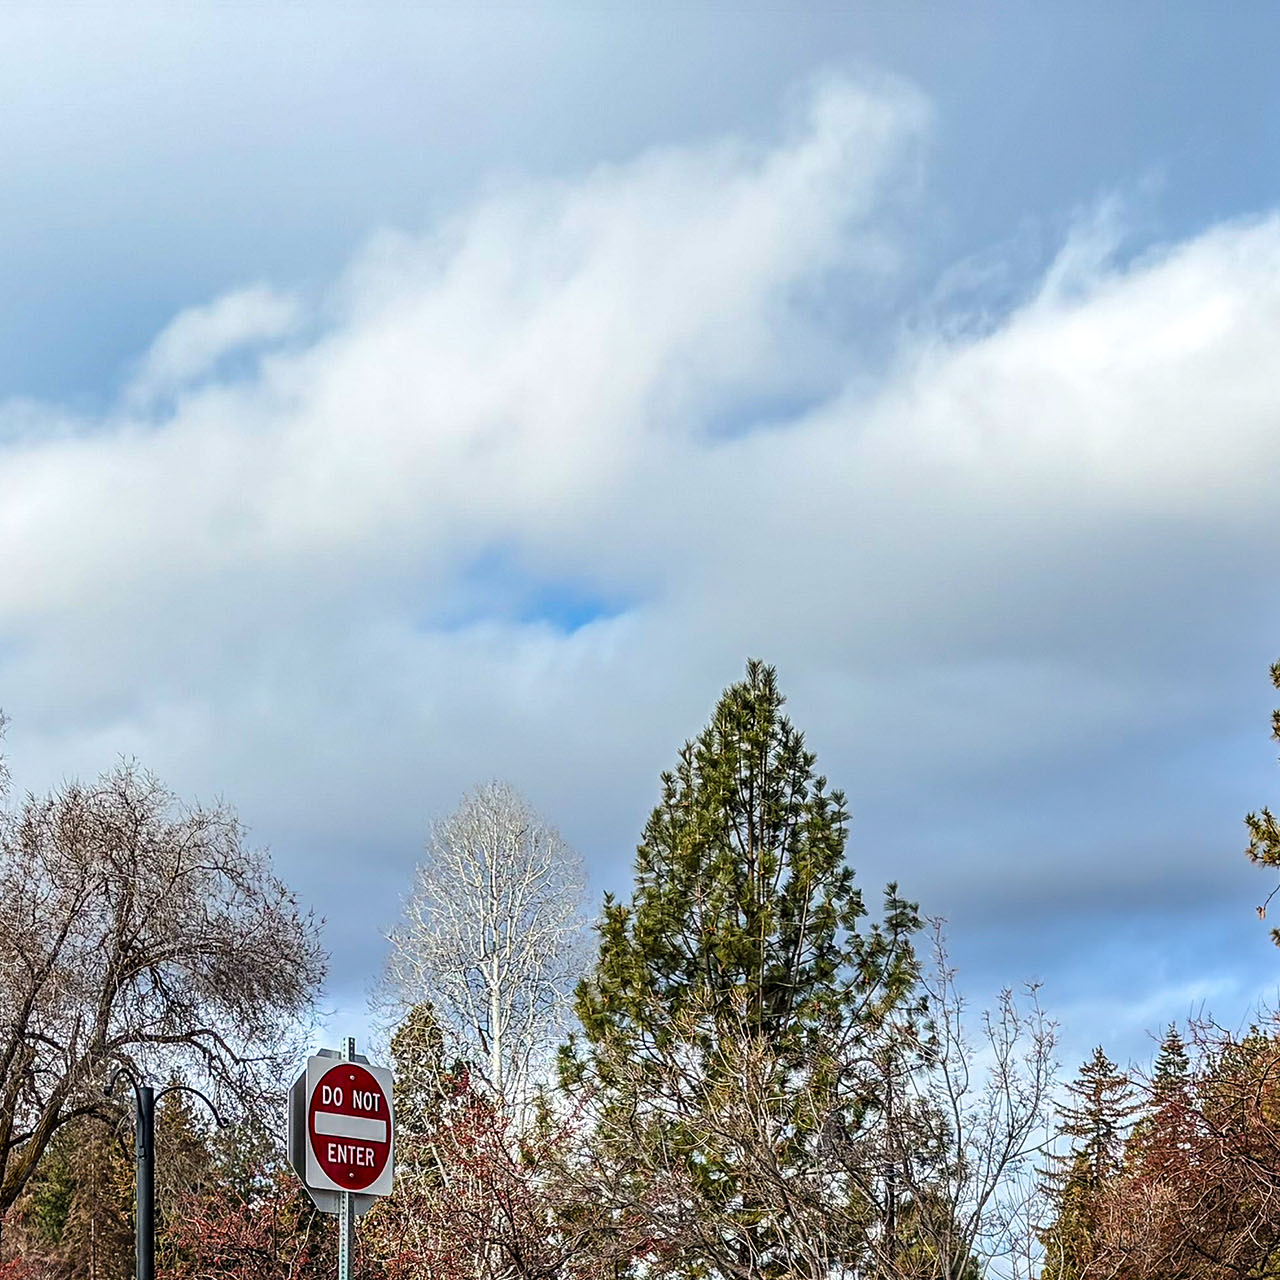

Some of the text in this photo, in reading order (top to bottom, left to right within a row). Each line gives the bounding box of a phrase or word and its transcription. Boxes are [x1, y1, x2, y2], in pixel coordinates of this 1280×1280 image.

[322, 1085, 381, 1112] DO NOT
[327, 1142, 375, 1167] ENTER
